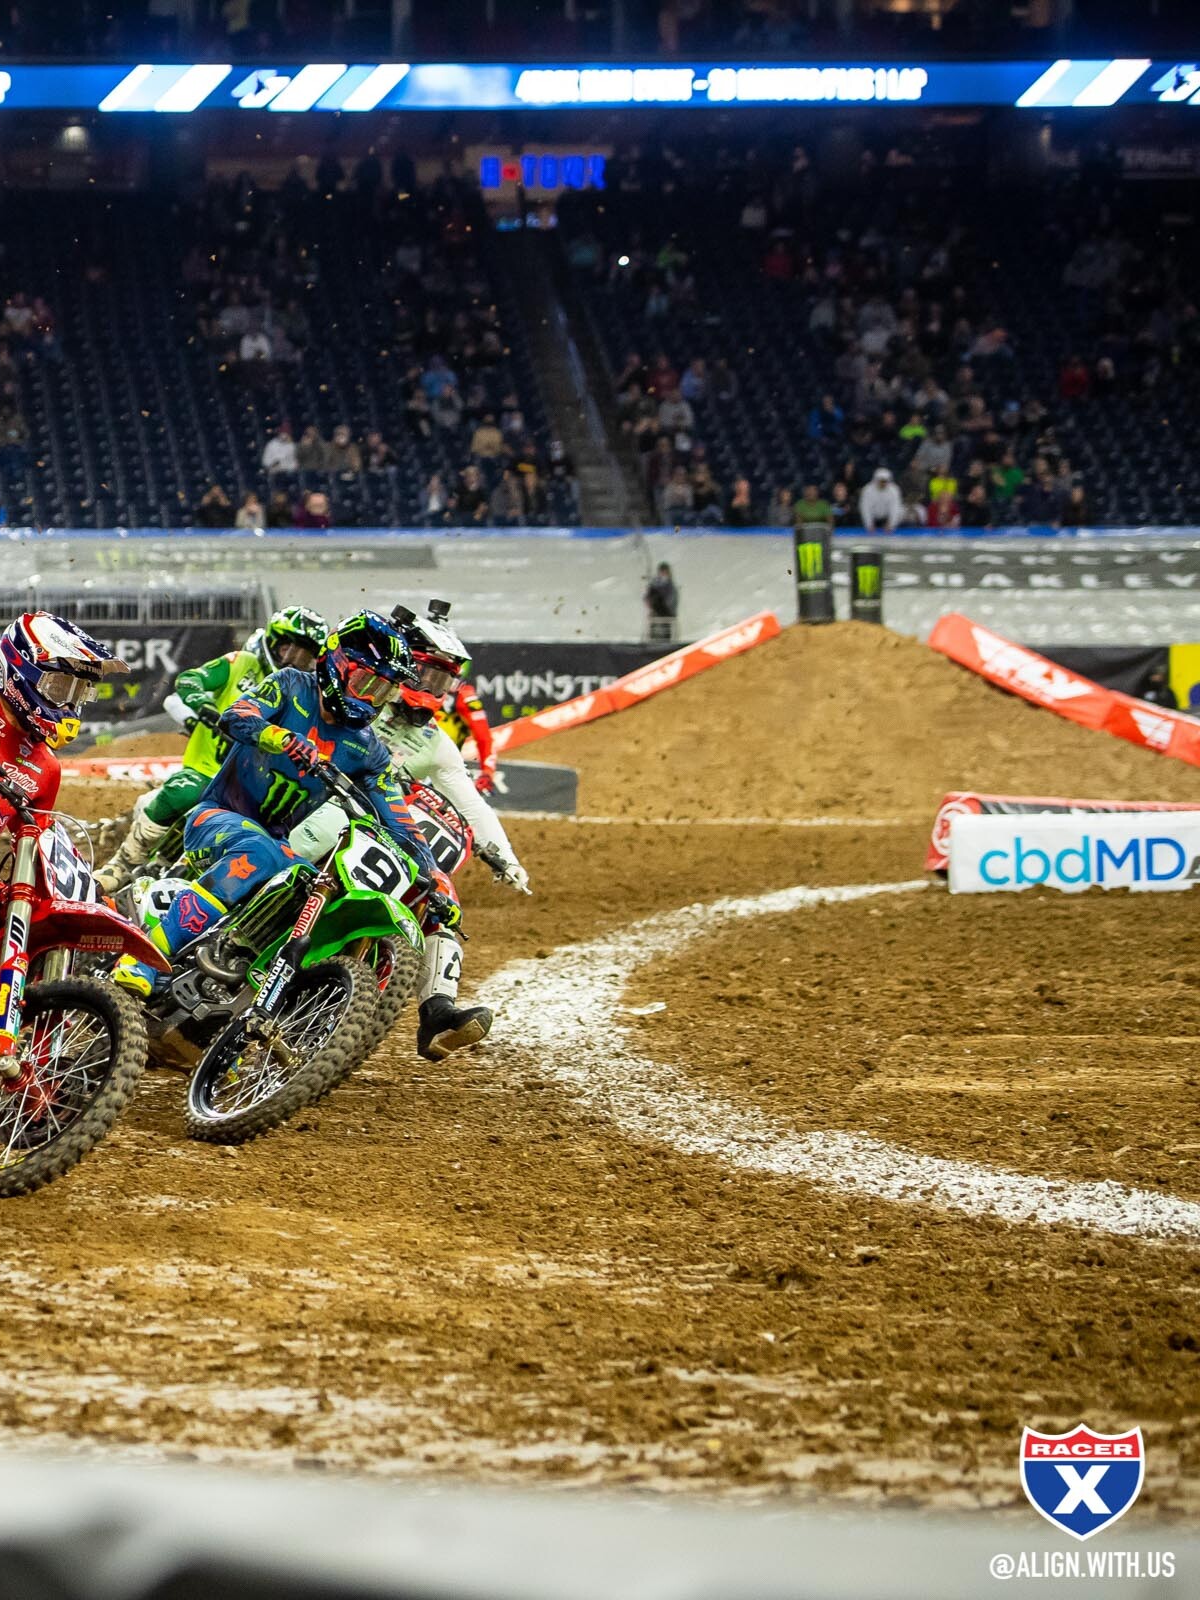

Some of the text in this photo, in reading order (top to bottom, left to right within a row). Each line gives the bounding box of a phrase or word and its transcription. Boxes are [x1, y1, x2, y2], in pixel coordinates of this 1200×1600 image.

[46, 840, 92, 902] 51
[351, 846, 402, 896] 9
[414, 820, 459, 875] 40
[978, 835, 1186, 885] cbdMD
[253, 957, 287, 1008] DUNLOP
